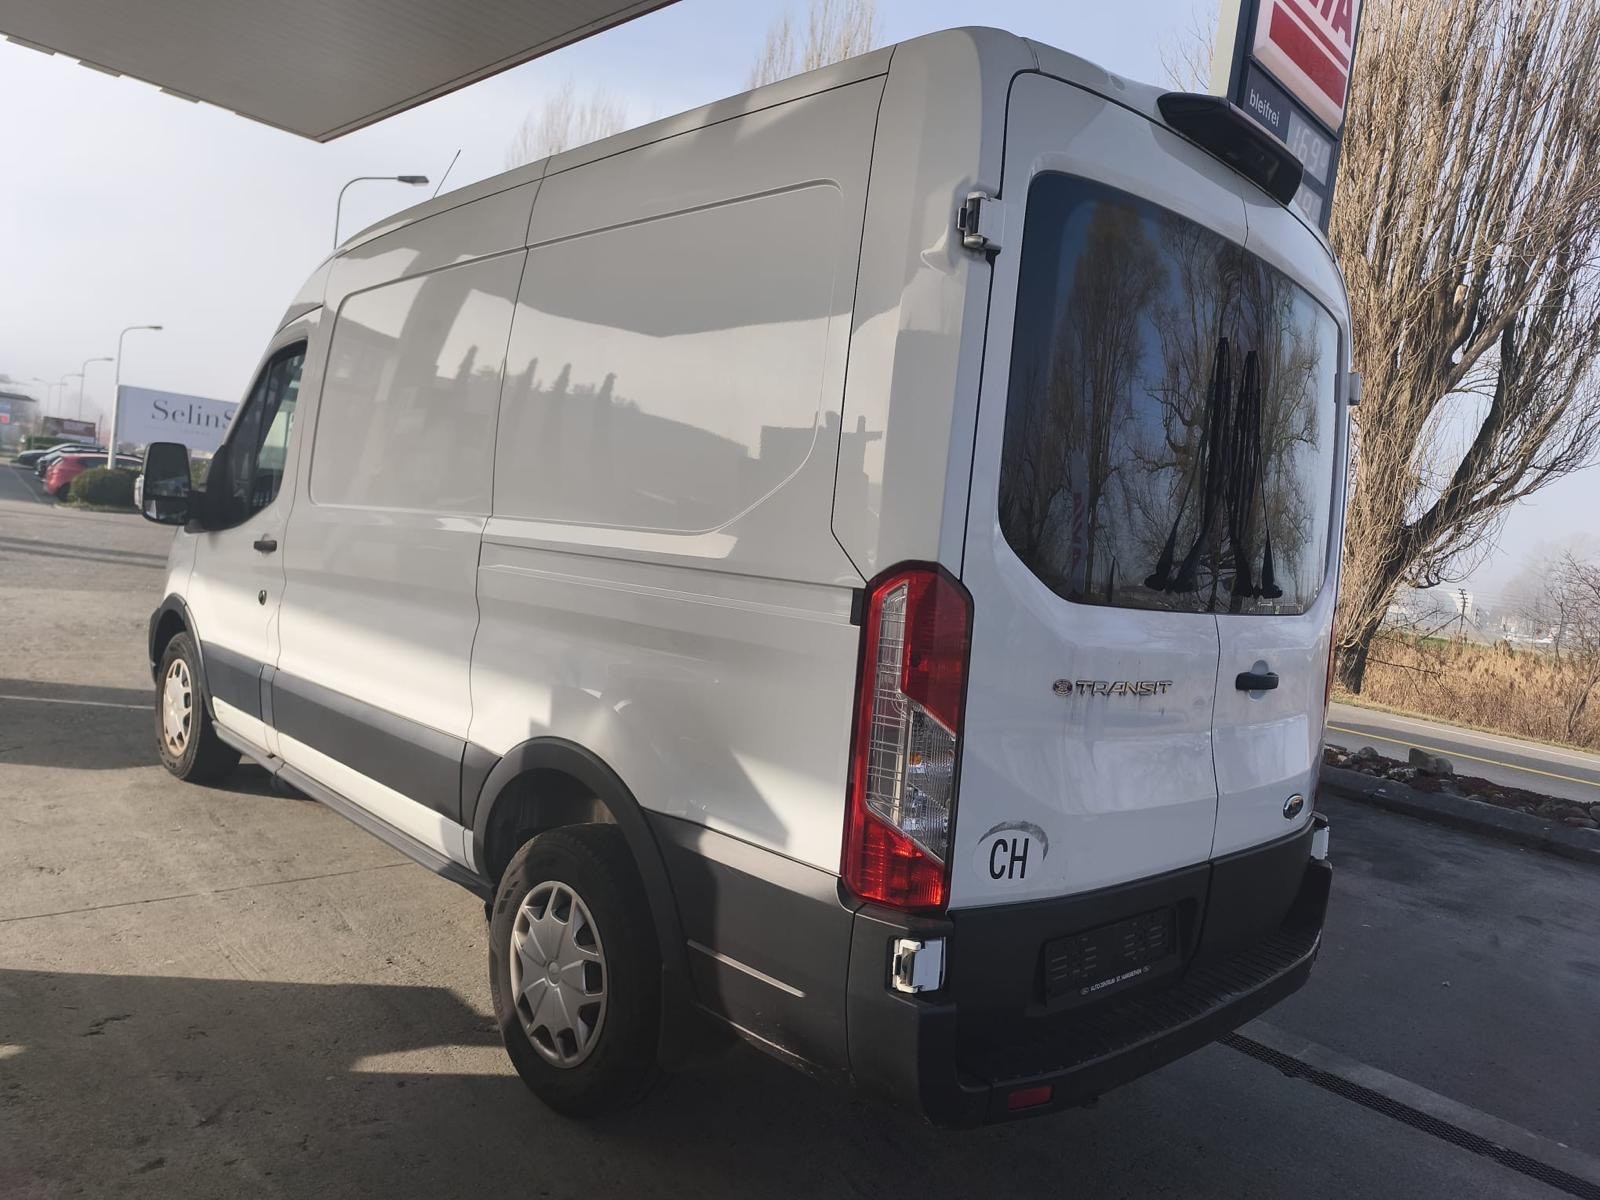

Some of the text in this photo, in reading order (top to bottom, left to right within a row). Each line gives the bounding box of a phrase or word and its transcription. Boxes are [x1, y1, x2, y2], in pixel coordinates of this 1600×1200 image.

[1249, 88, 1280, 127] bleifrei
[1075, 679, 1174, 697] TRANSIT
[989, 838, 1029, 880] CH
